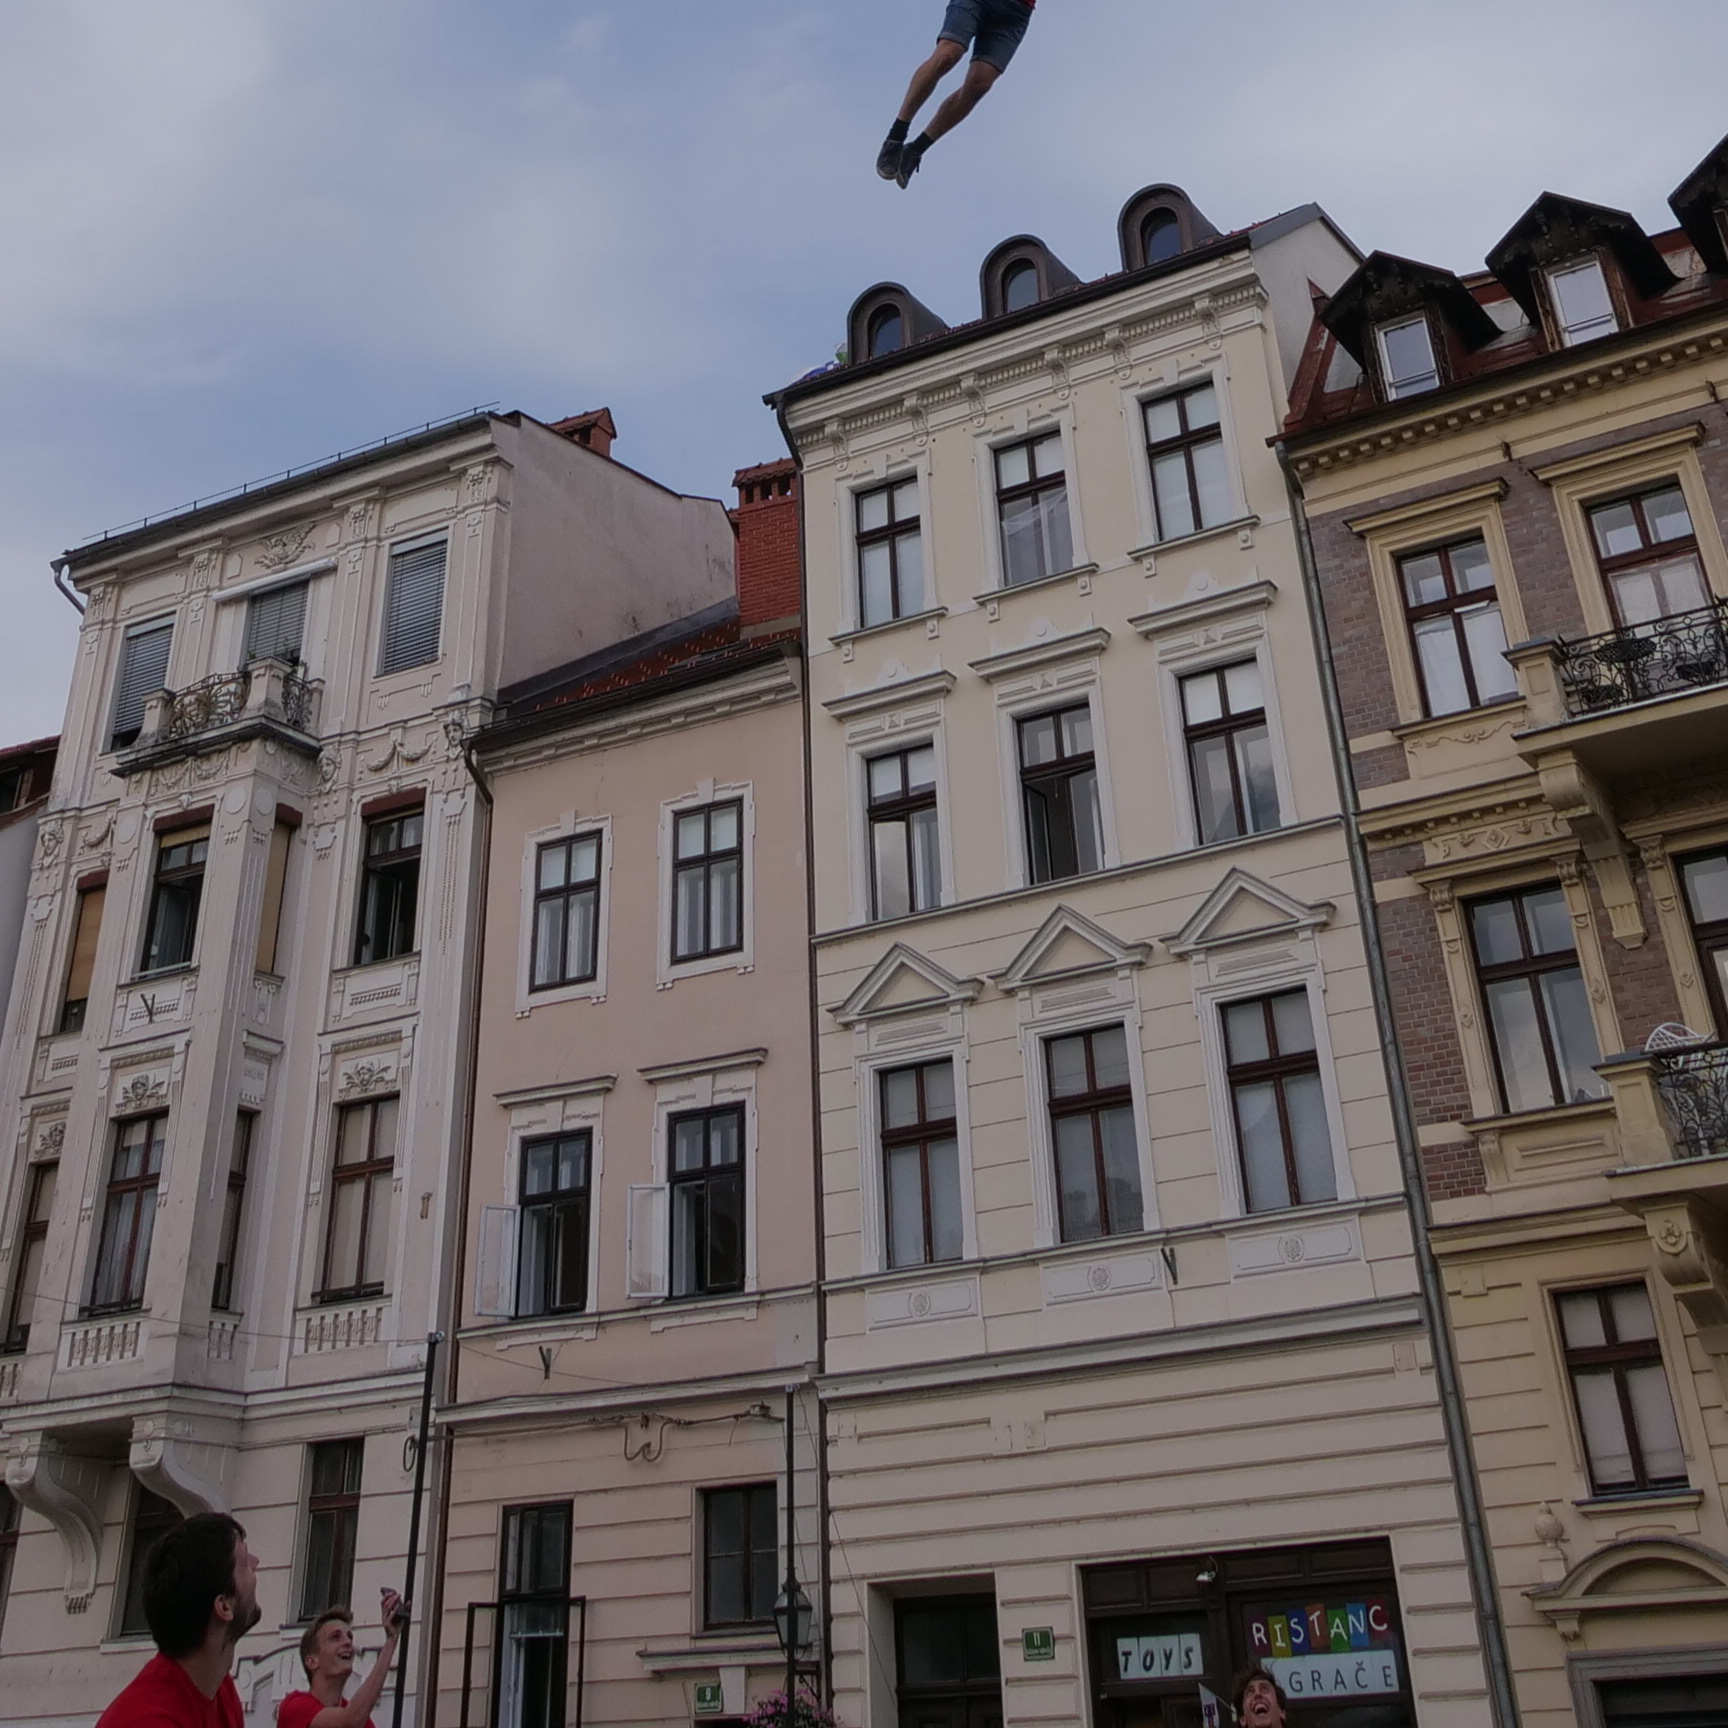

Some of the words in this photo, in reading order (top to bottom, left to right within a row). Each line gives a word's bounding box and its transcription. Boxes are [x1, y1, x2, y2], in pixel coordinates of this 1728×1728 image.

[1252, 1604, 1388, 1648] RISTANC
[1121, 1645, 1193, 1673] TOYS
[1288, 1660, 1394, 1693] GRAČE
